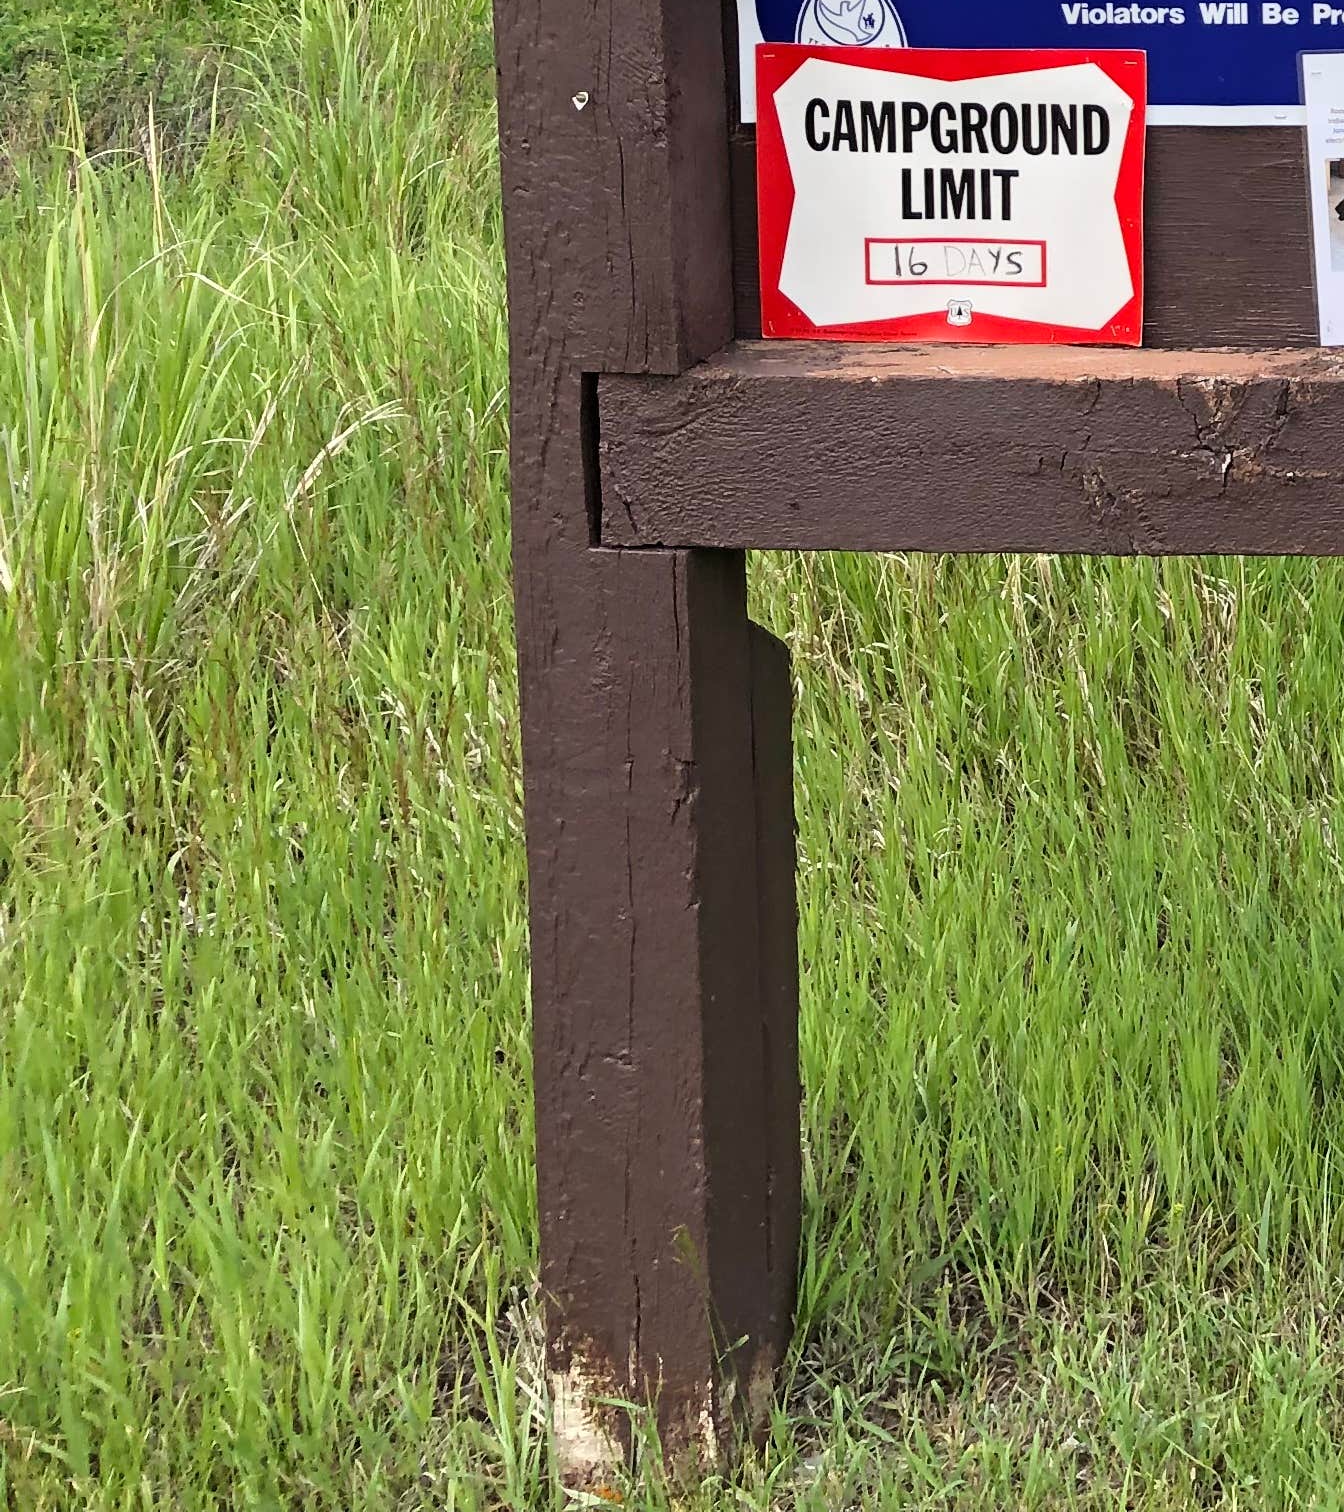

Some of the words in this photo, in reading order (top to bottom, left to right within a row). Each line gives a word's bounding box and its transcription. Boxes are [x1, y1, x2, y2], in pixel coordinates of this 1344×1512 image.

[1062, 3, 1185, 24] Violators
[1199, 3, 1248, 24] Will
[1262, 3, 1299, 24] Be
[805, 98, 1110, 155] CAMPGROUND
[902, 168, 1019, 220] LIMIT
[895, 244, 928, 276] 16
[944, 245, 1022, 276] DAYS
